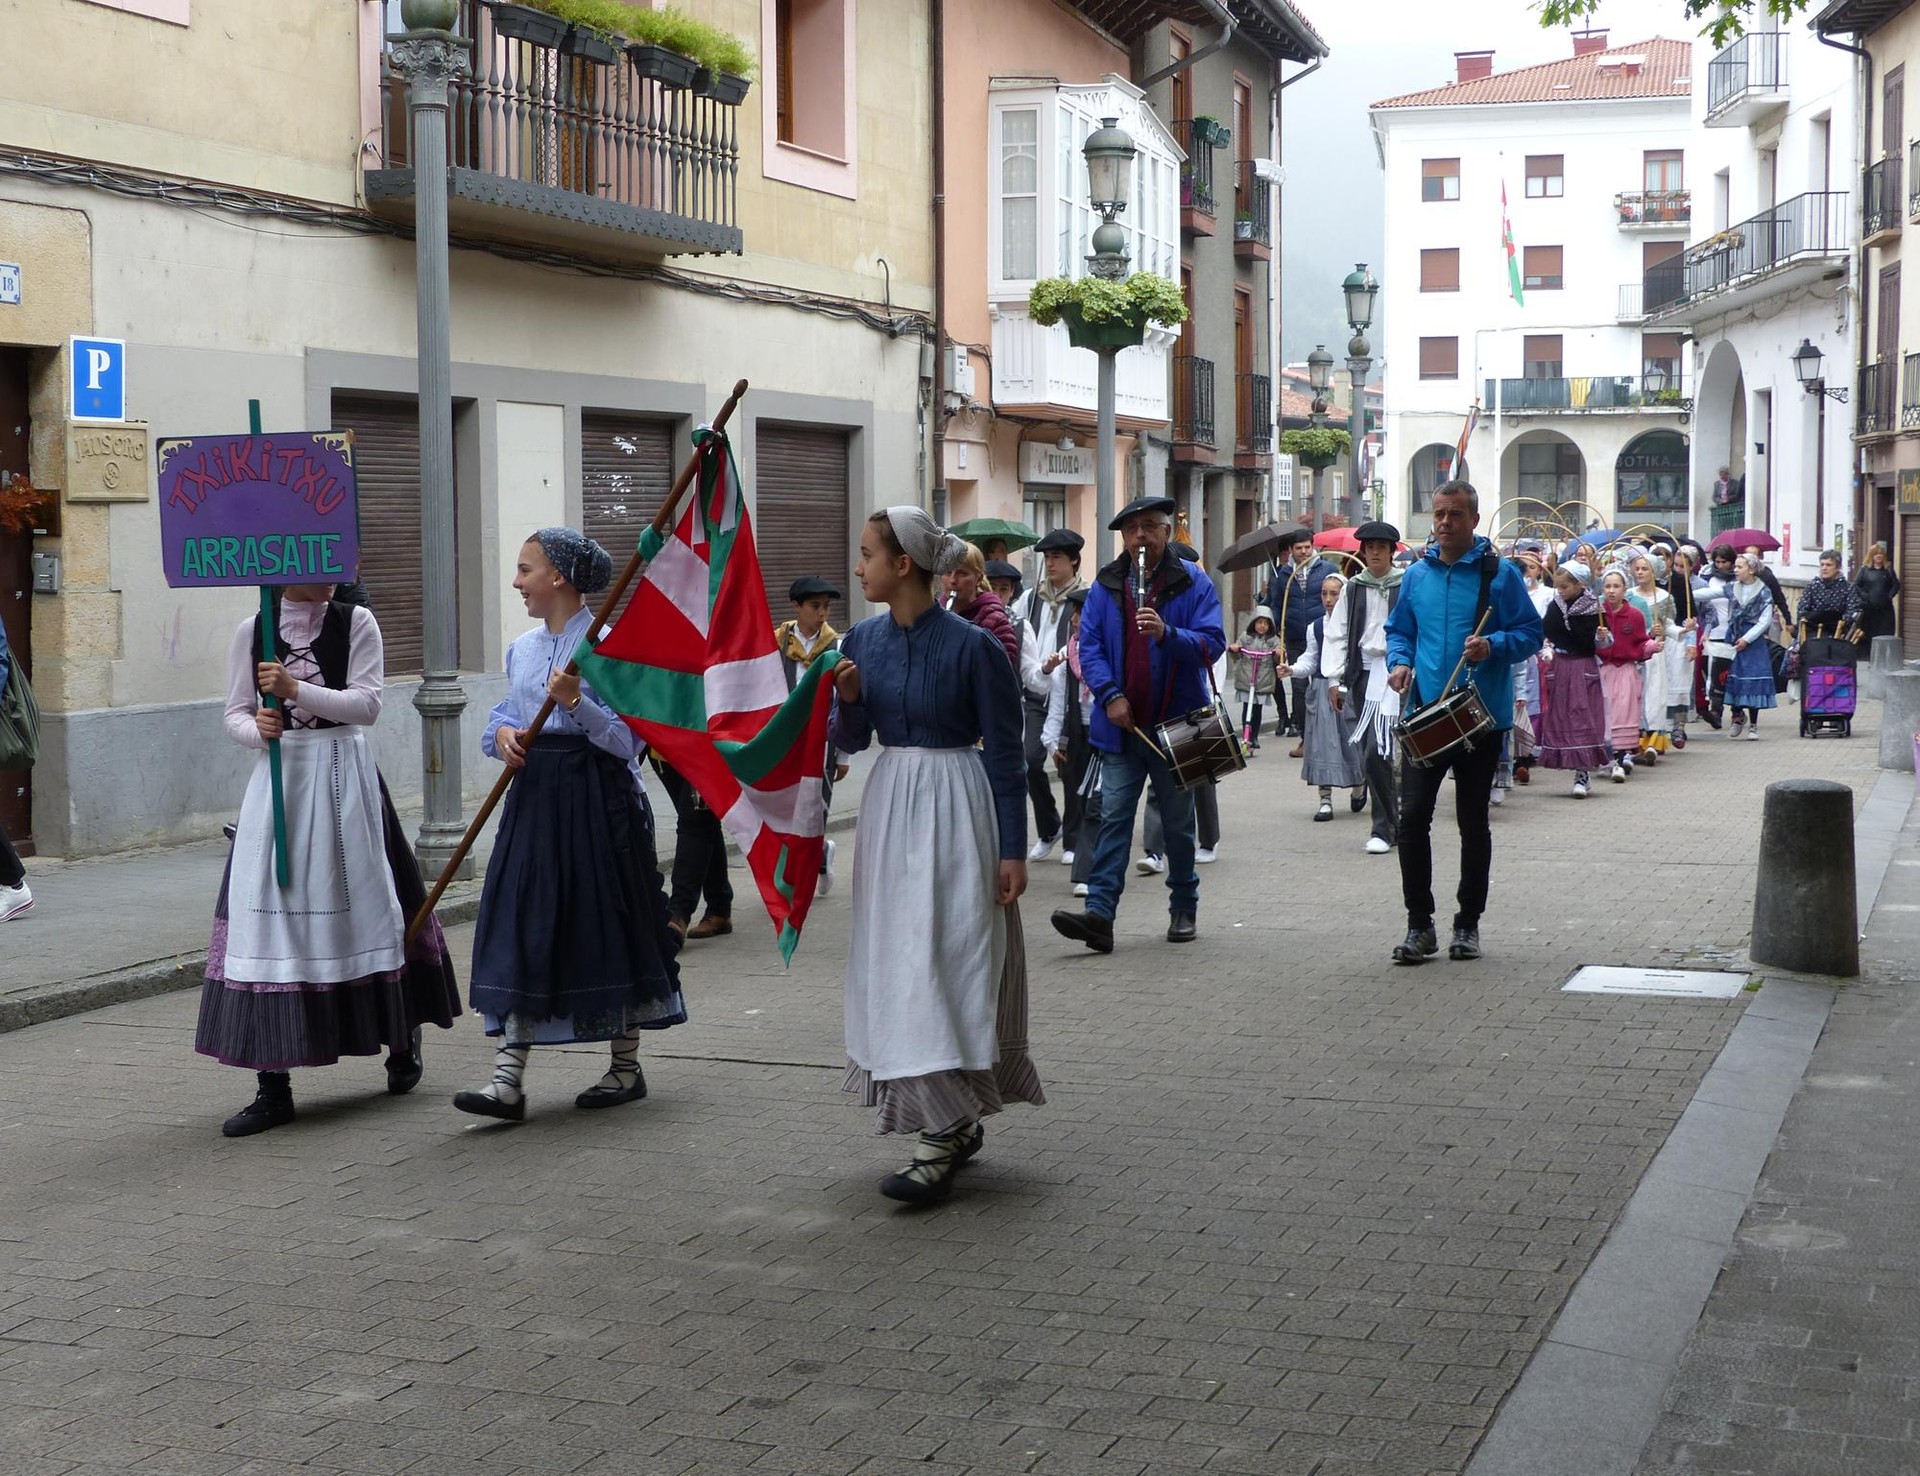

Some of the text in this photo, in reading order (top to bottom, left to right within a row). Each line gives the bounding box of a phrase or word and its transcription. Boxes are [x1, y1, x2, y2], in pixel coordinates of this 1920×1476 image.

[3, 276, 14, 292] 18
[86, 348, 111, 389] P
[182, 533, 343, 577] ARRASATE
